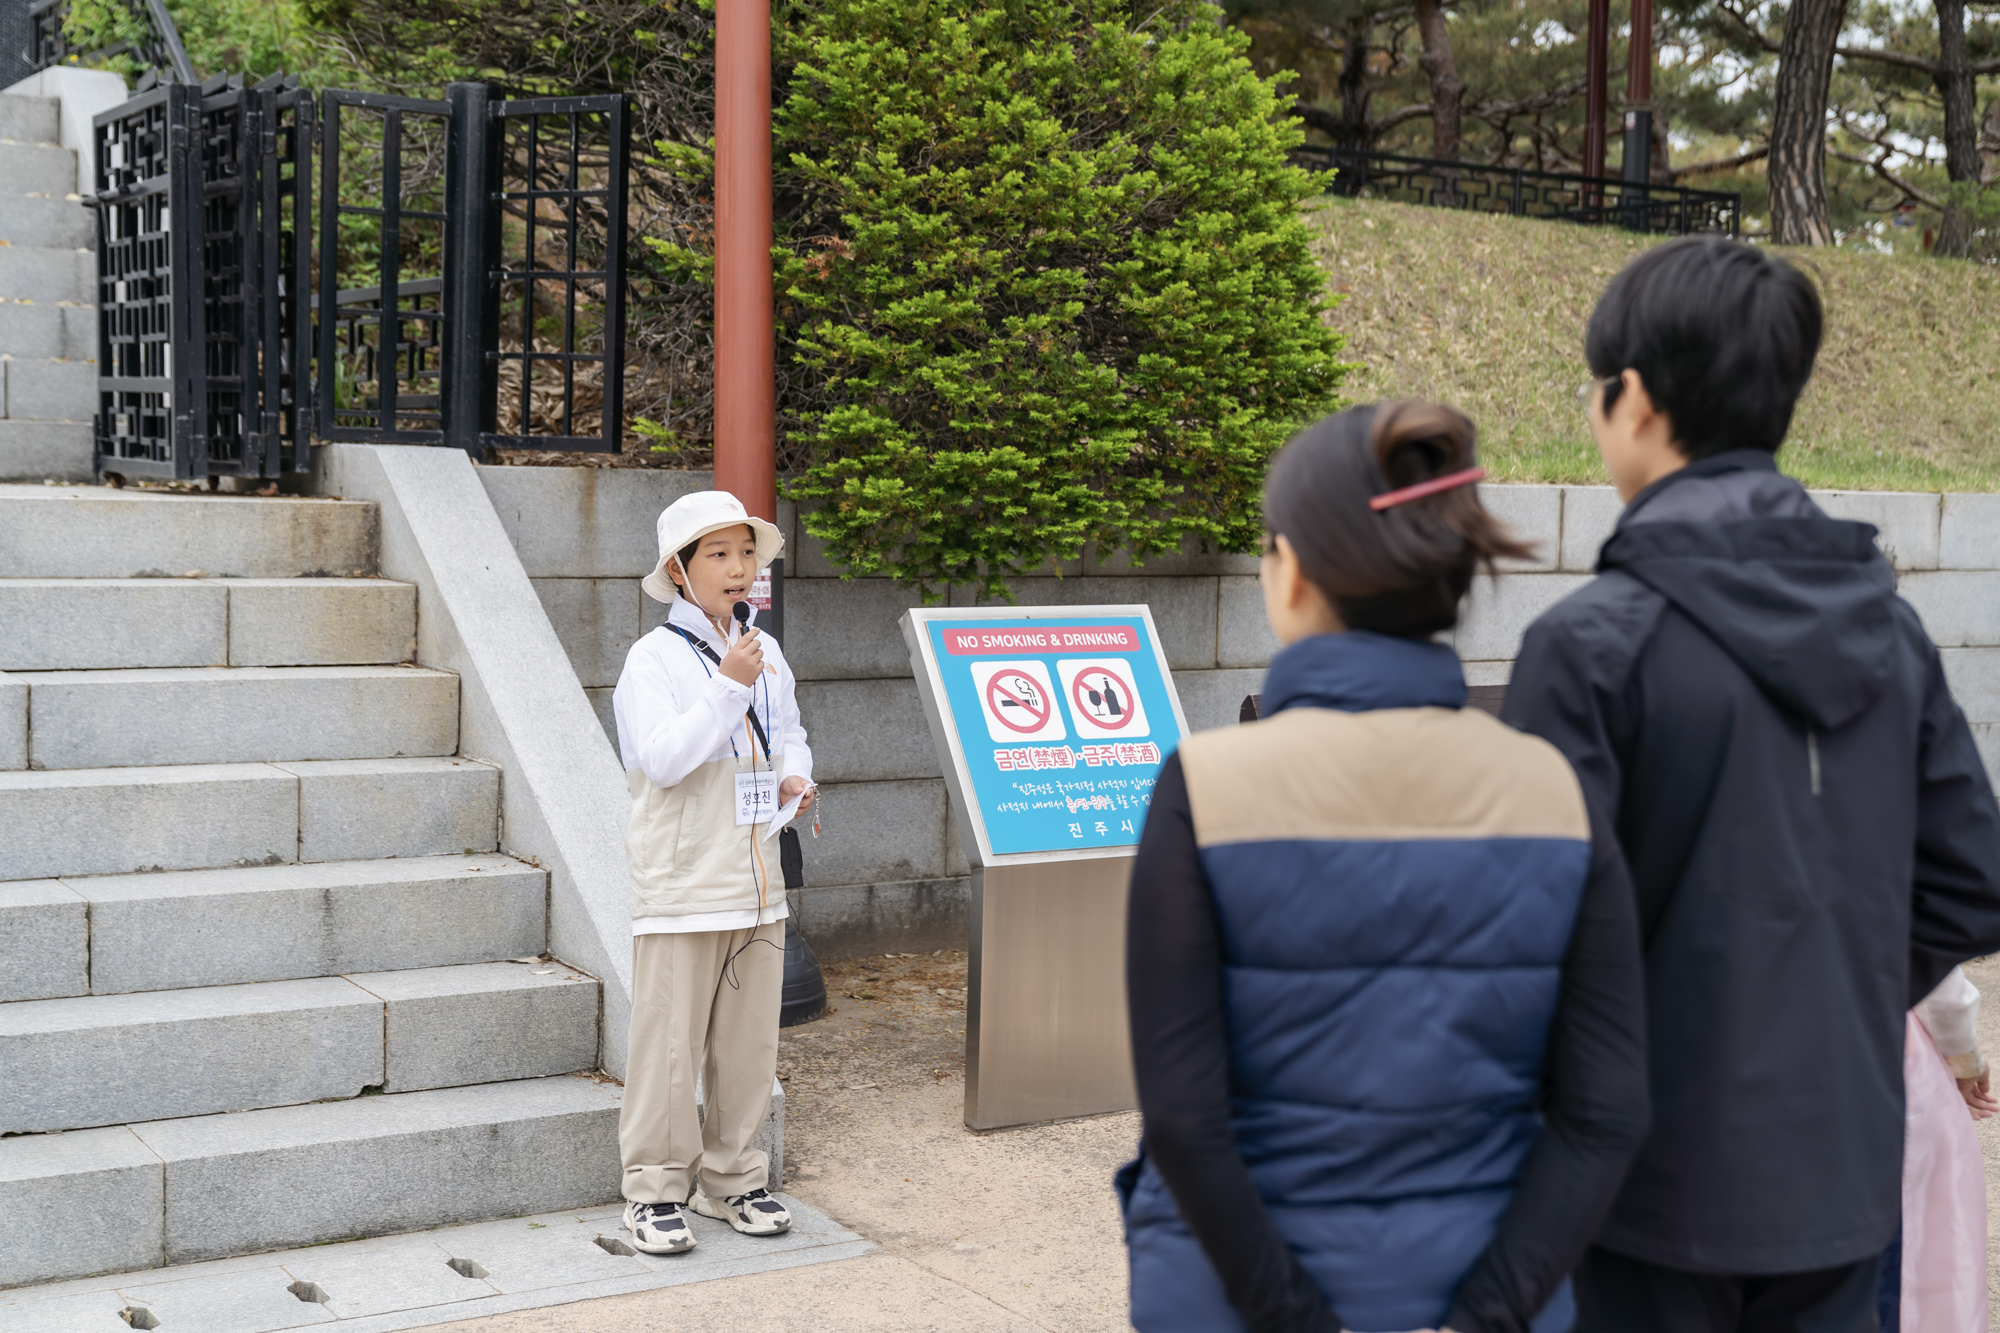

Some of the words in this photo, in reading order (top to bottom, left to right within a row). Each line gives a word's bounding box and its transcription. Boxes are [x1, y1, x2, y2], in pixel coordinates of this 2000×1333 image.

[956, 635, 978, 648] NO
[982, 633, 1047, 648] SMOKING
[1050, 634, 1062, 646] &
[1064, 632, 1128, 646] DRINKING
[1056, 780, 1095, 796] 국가지정
[1098, 779, 1128, 791] 사적지
[997, 801, 1029, 814] 사적지
[1032, 800, 1065, 810] 내에서
[1115, 794, 1130, 809] 할
[1130, 794, 1139, 805] 수
